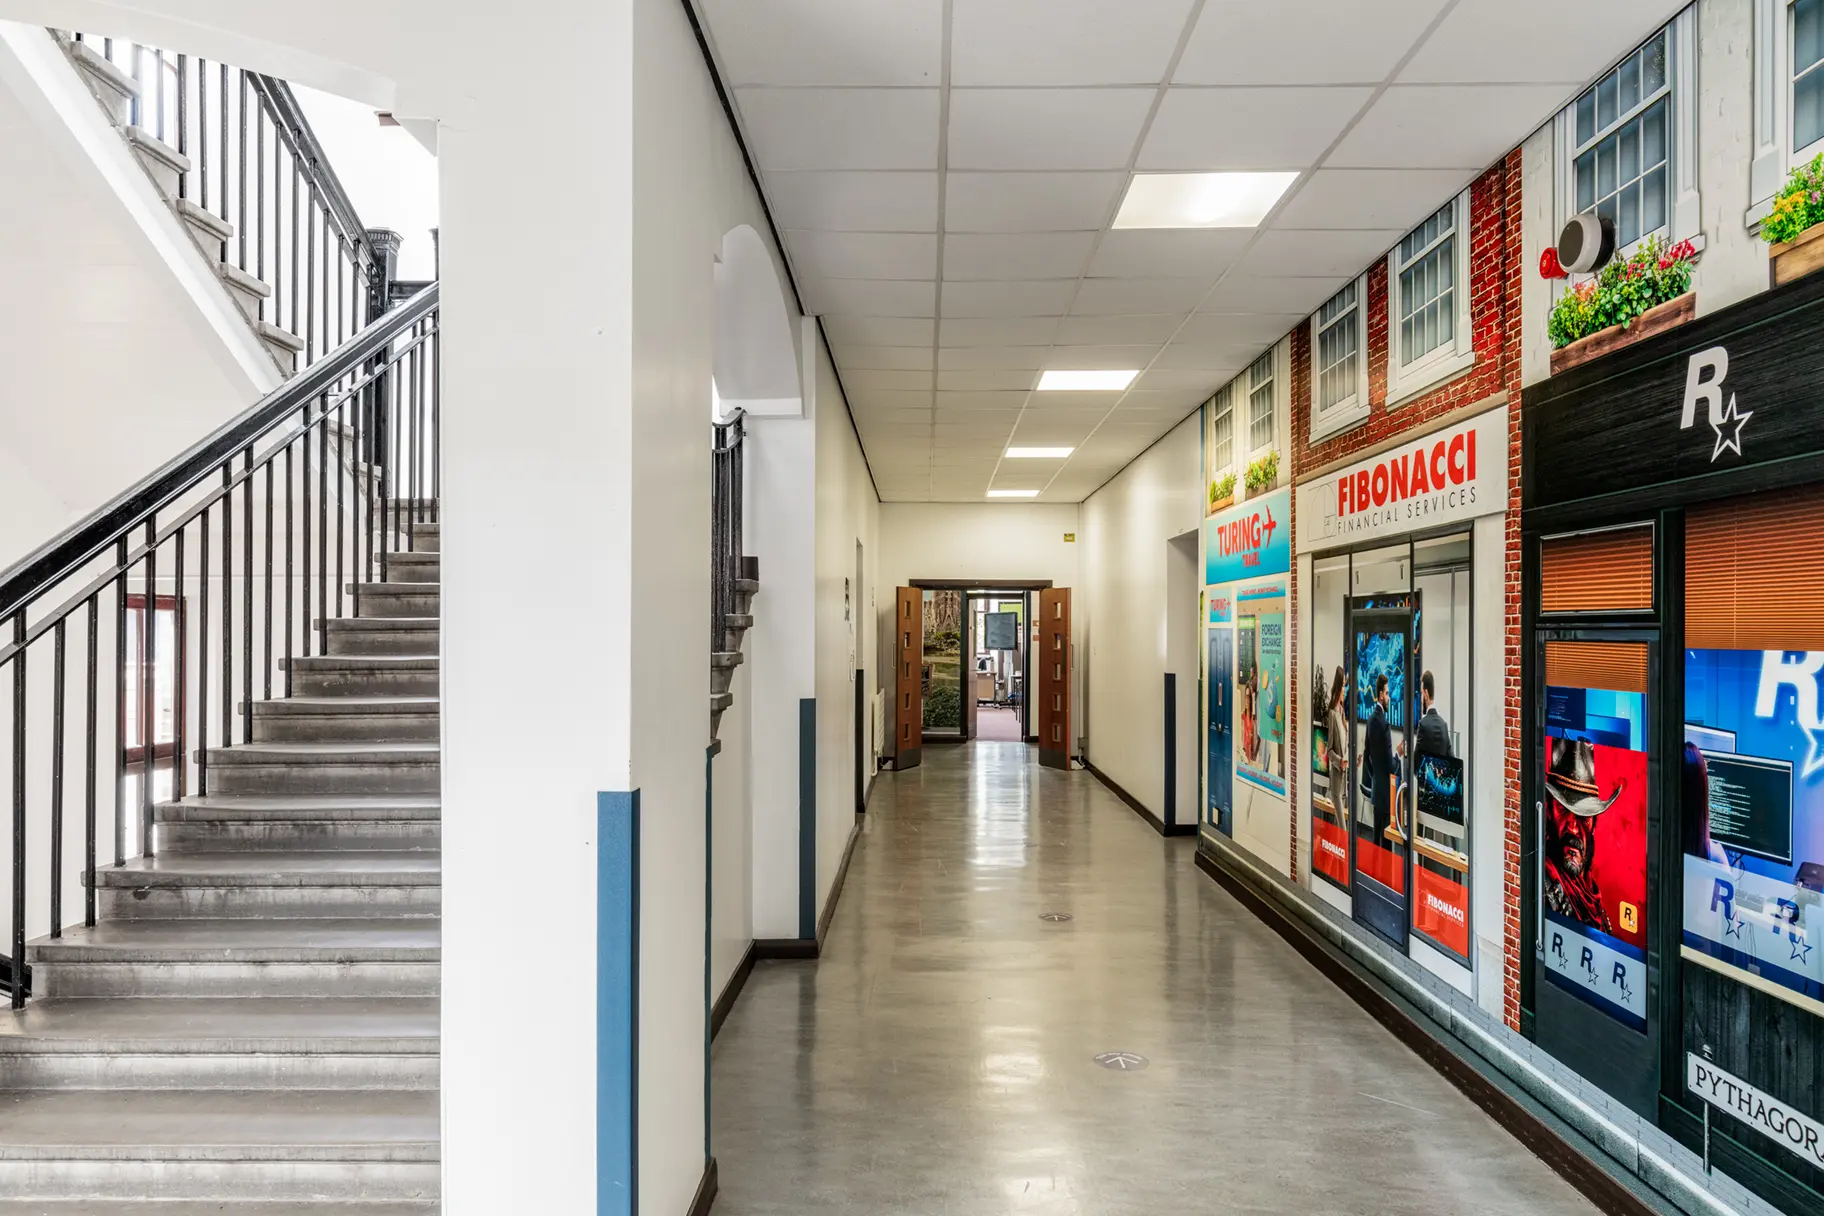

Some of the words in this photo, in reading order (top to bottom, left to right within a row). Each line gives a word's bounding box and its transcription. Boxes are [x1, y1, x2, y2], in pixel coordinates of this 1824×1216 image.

[1338, 429, 1476, 517] FIBONACCI
[1338, 508, 1398, 534] FINANCIAL
[1407, 487, 1476, 519] SERVICES
[1217, 513, 1261, 558] TURING
[1321, 839, 1346, 860] FIBONACCI
[1427, 893, 1464, 923] FIBONACCI
[1696, 1064, 1824, 1163] PYTHAGOR
